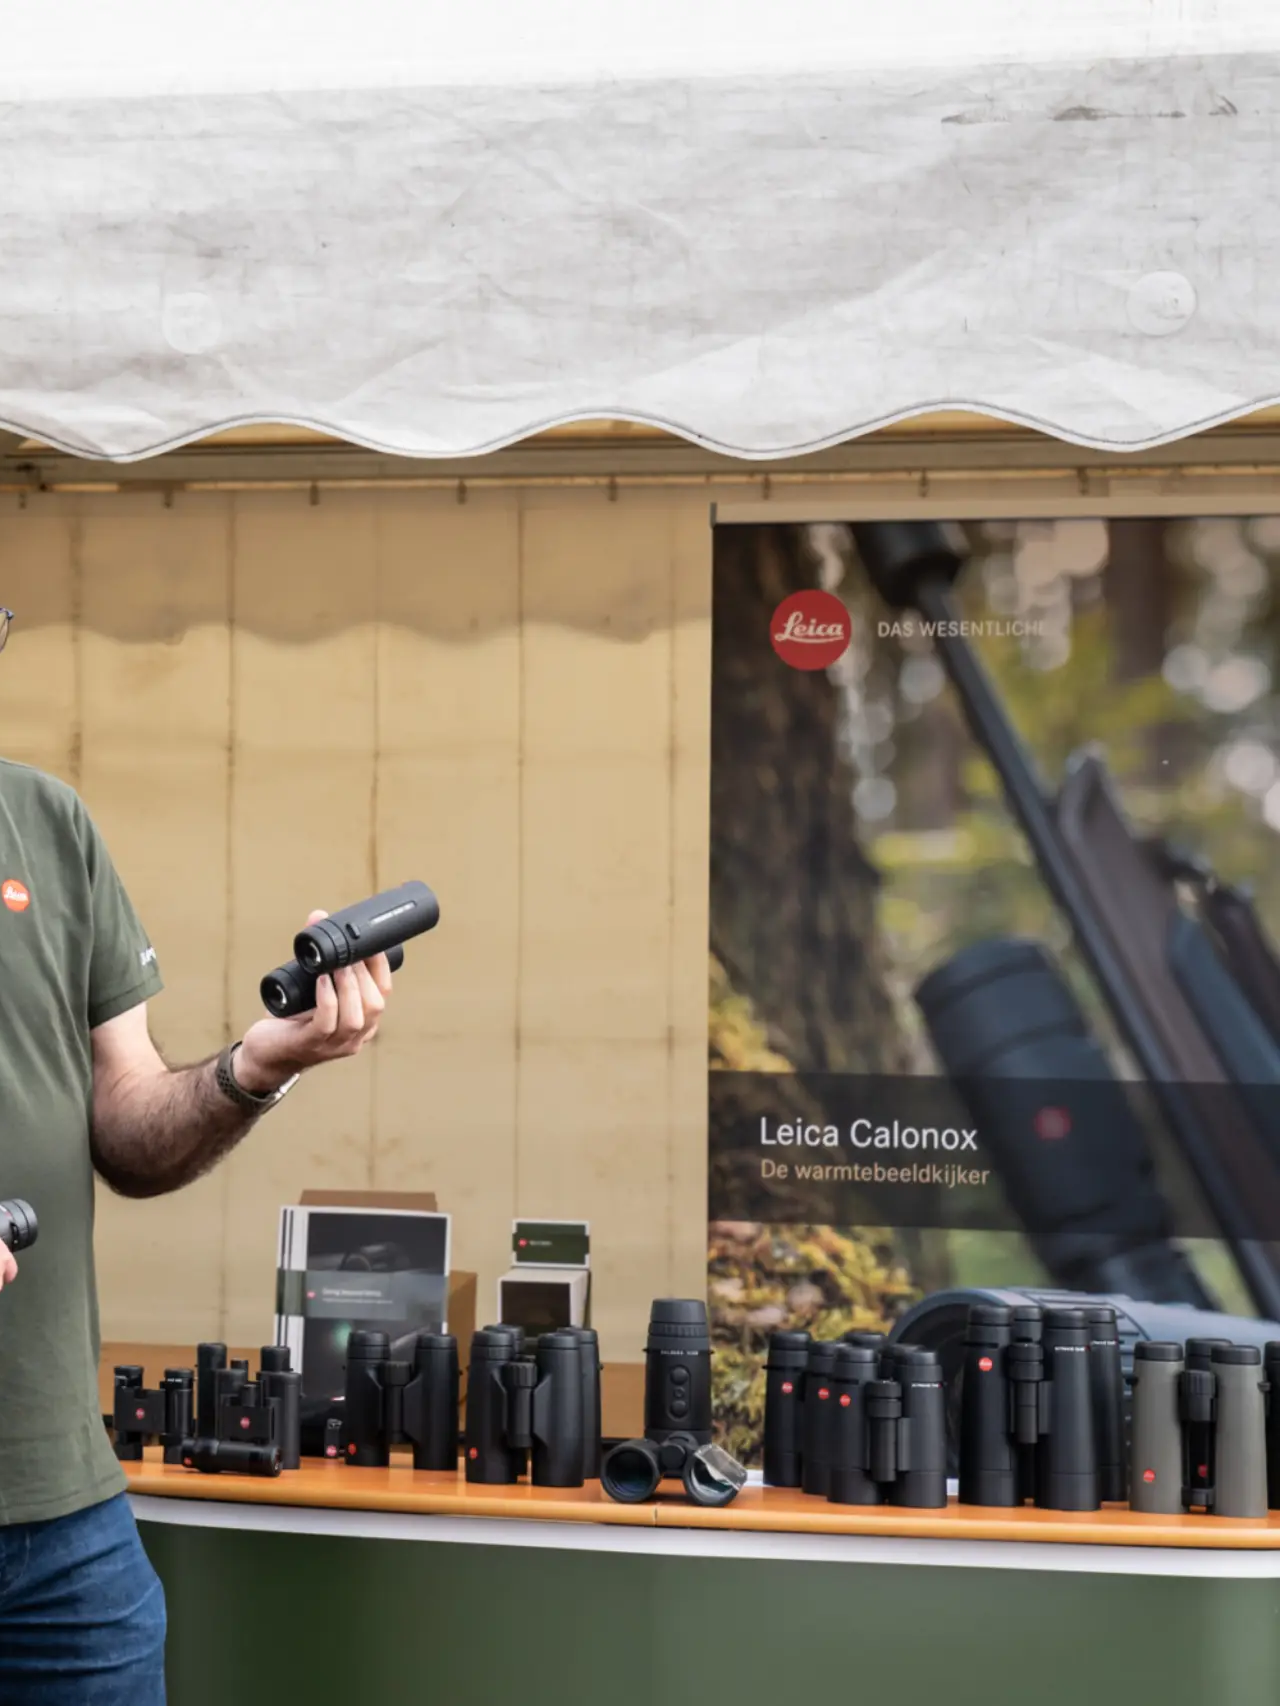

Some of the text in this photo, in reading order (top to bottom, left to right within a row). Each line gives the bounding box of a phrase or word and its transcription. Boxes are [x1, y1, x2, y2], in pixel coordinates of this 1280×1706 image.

[774, 611, 845, 644] Leica
[877, 620, 914, 638] DAS
[760, 1116, 978, 1151] Leica Calonox
[760, 1158, 991, 1189] De warmtebeeldkijker
